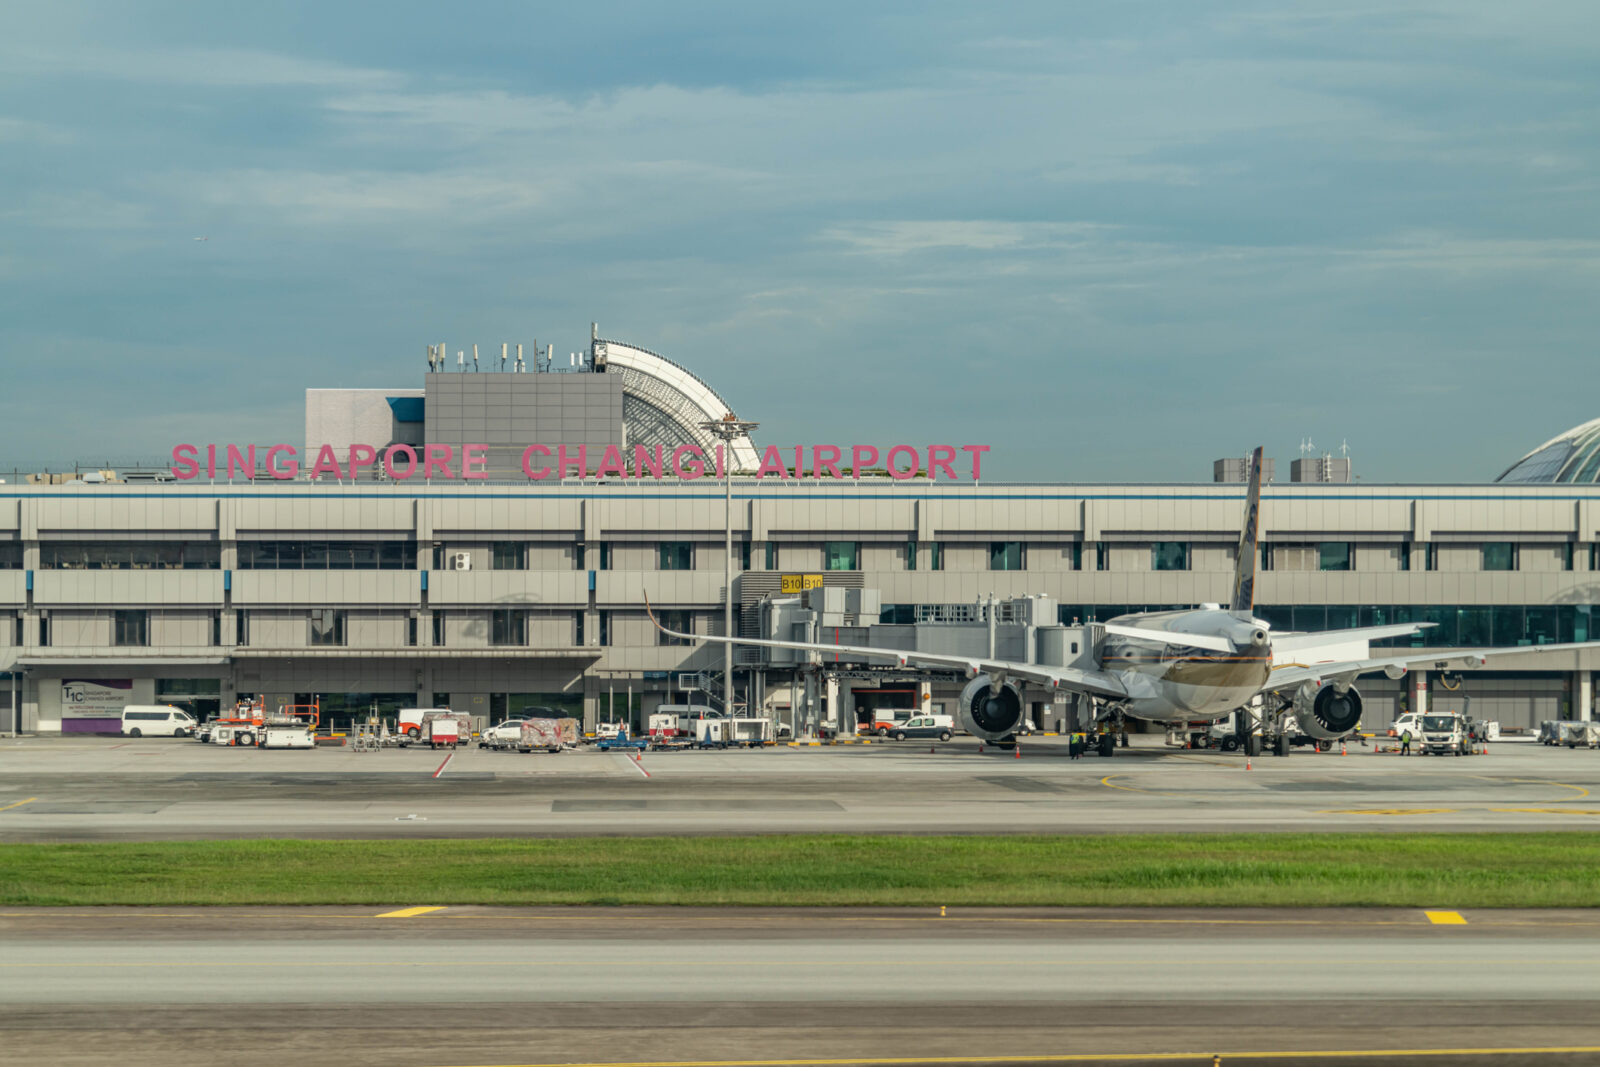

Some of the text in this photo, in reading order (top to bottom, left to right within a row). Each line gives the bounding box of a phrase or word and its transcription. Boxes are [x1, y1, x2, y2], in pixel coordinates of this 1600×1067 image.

[171, 443, 990, 480] SINGAPORE CHANGI AIRPORT
[782, 579, 801, 590] B10
[804, 579, 822, 589] B10
